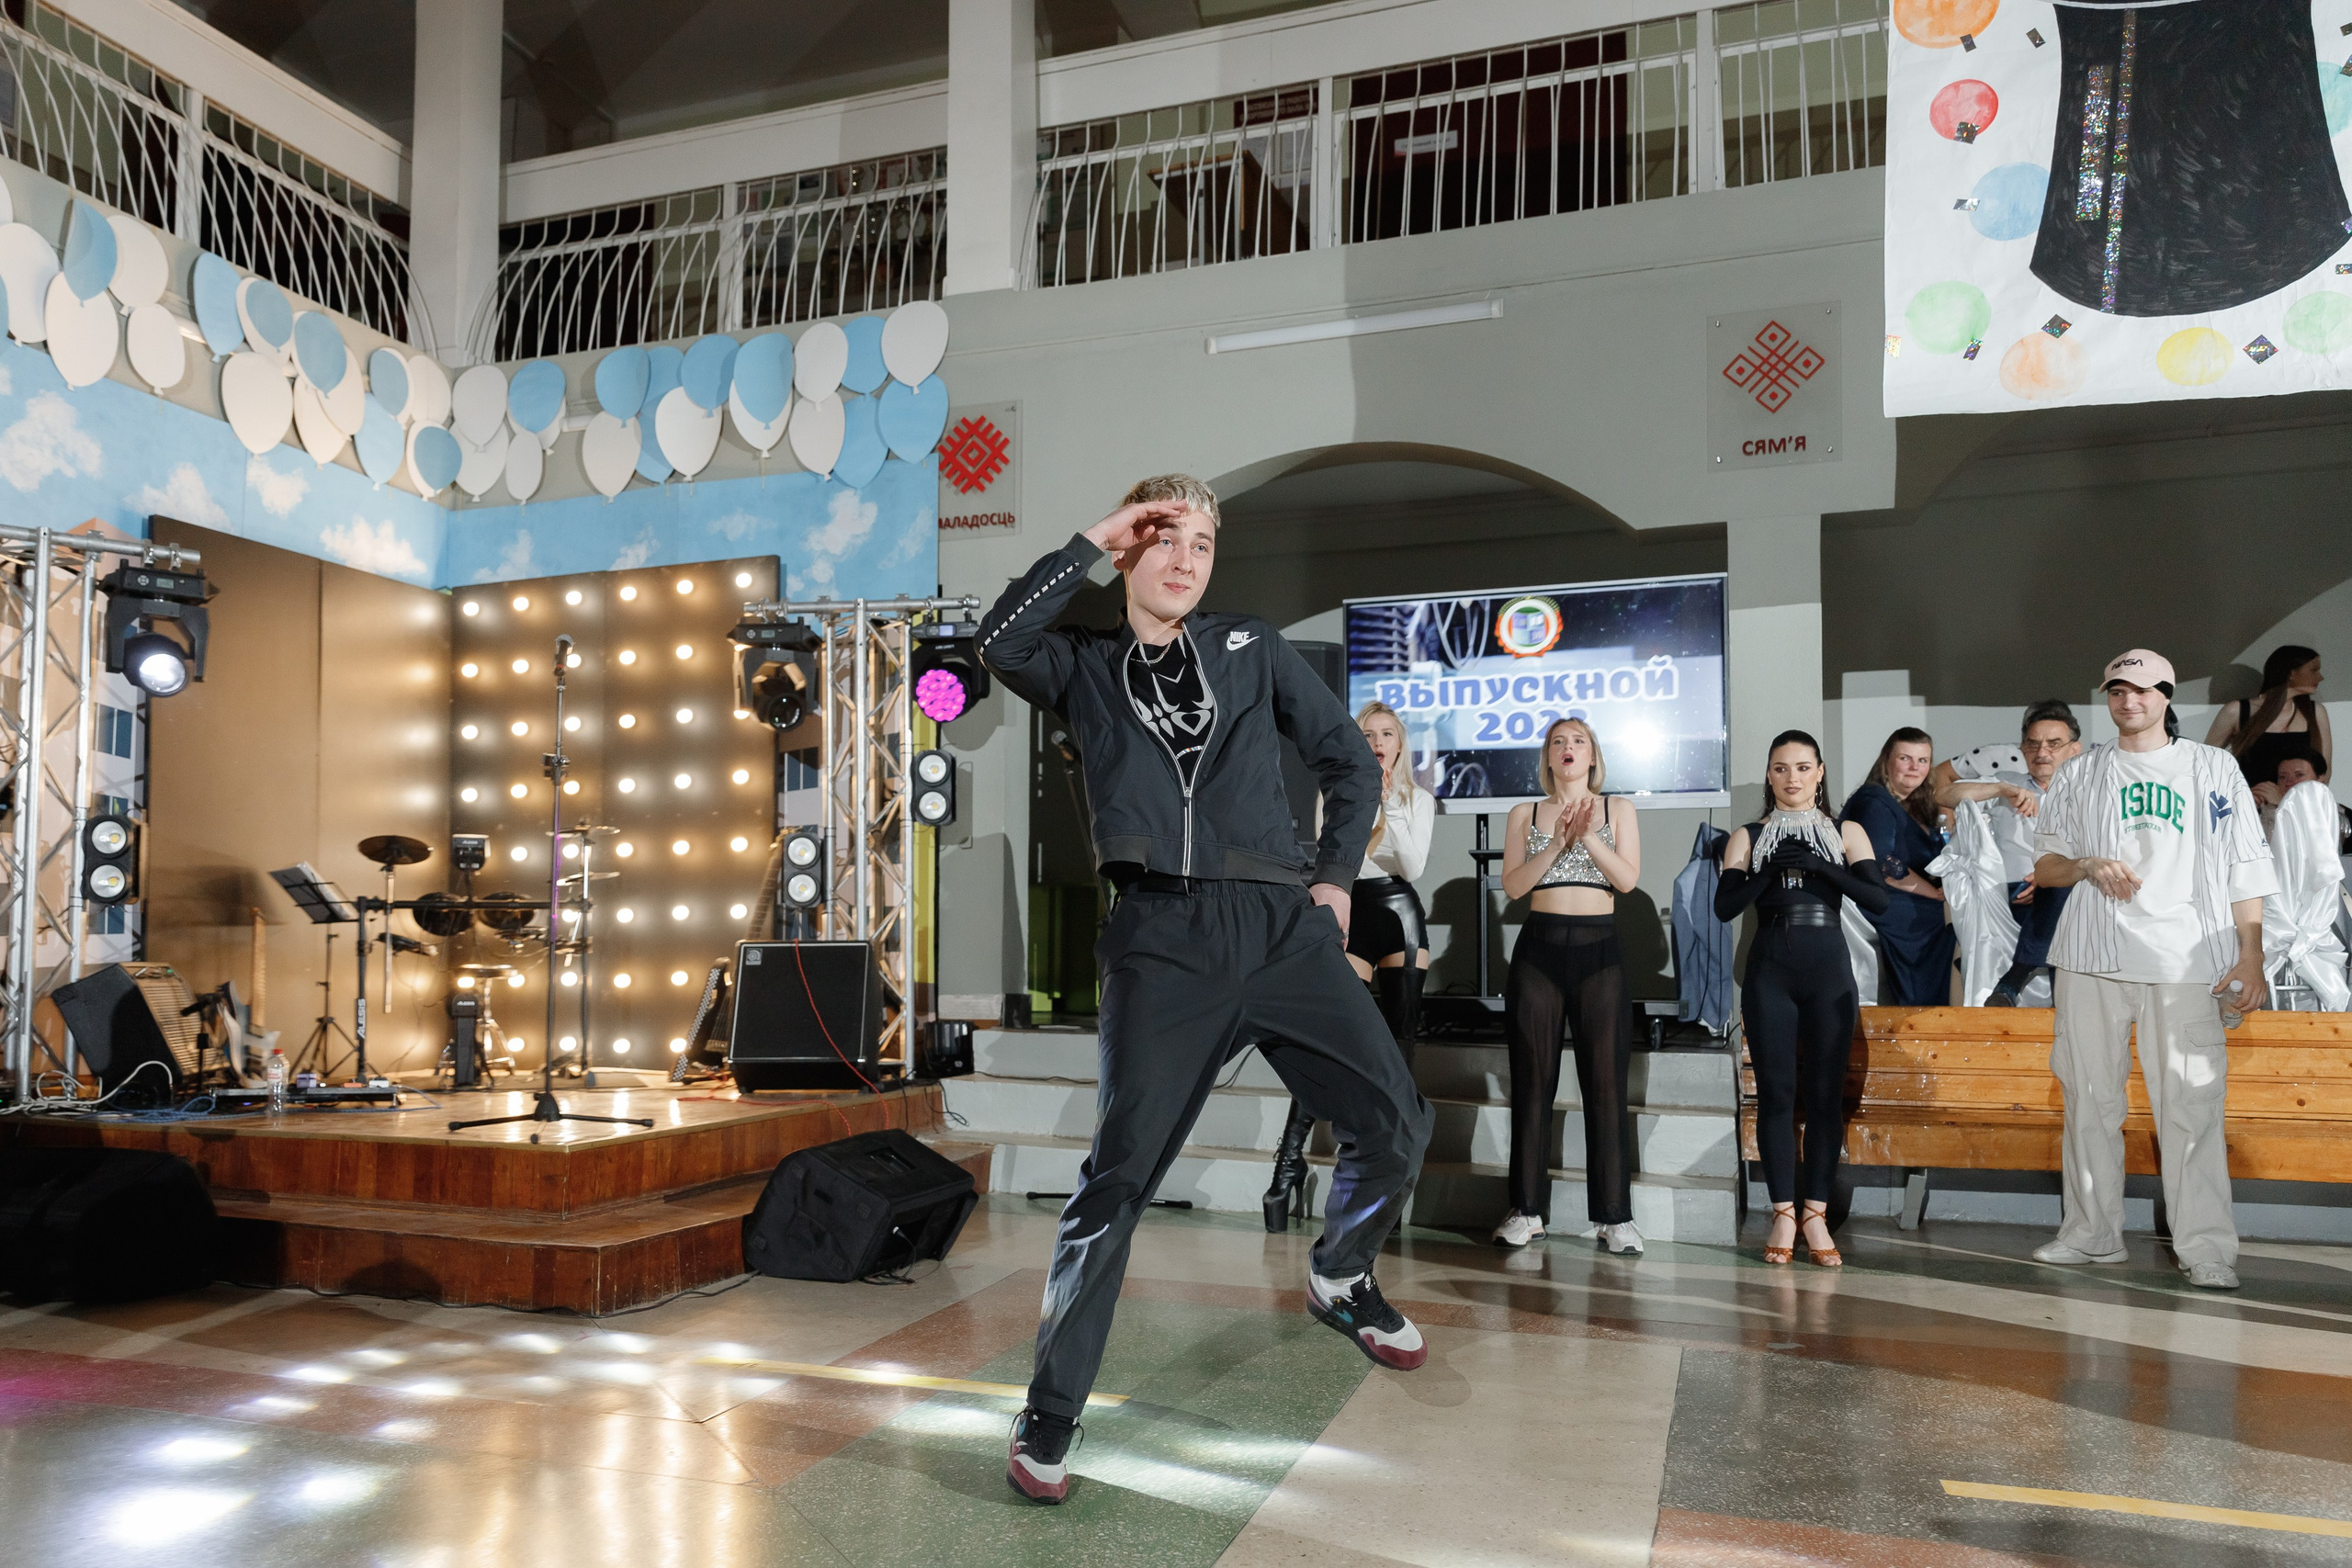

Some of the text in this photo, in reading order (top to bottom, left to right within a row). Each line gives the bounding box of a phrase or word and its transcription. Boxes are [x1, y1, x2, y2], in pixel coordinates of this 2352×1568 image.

[1742, 435, 1806, 456] СЯМ'Я
[1230, 631, 1250, 642] NIKE
[2111, 659, 2143, 671] NASA
[1377, 656, 1679, 710] ВЫПУСКНОЙ
[1476, 707, 1589, 743] 202
